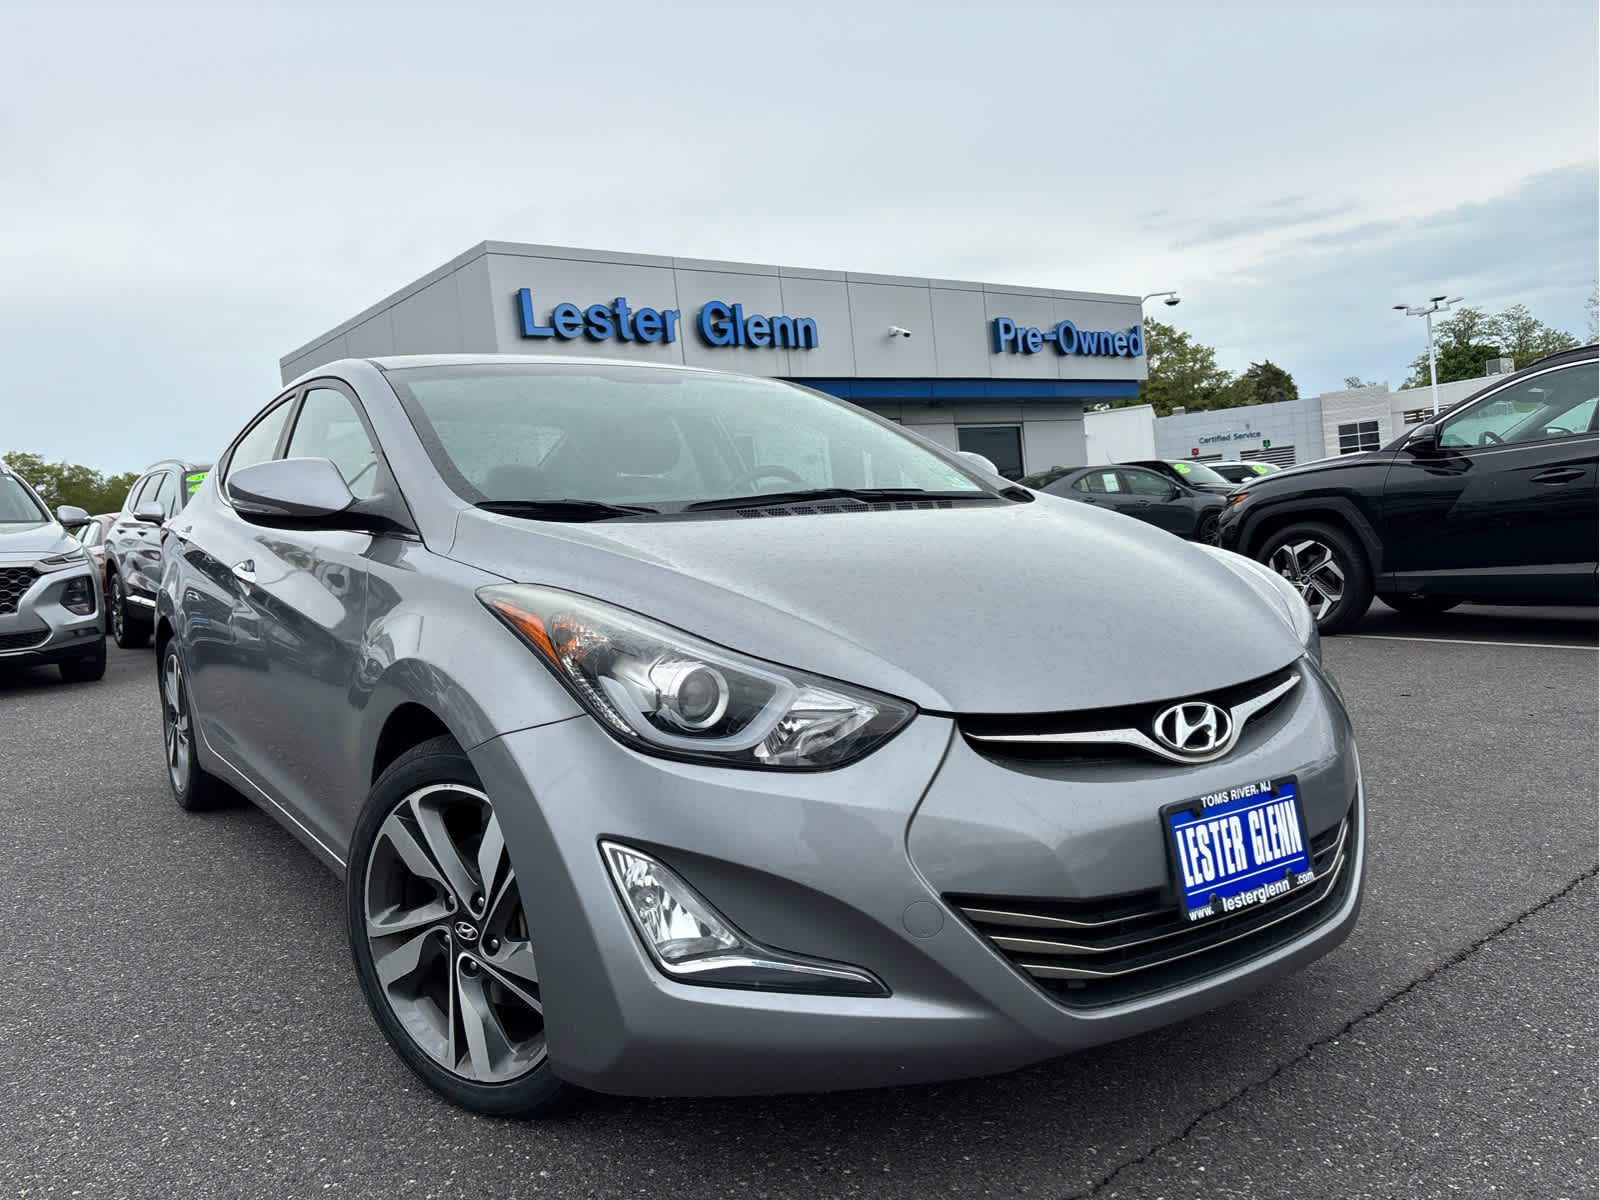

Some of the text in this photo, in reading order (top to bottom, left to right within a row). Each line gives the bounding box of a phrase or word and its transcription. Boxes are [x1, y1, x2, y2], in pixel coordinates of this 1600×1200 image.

[515, 287, 818, 349] Lester Glenn
[993, 317, 1143, 357] Pre-Owned
[1199, 431, 1261, 444] Certified Service
[1200, 791, 1229, 808] TOMS
[1260, 780, 1271, 793] NJ
[1175, 799, 1303, 888] LESTER GLENN
[1189, 871, 1314, 921] www. lesterglenn .com
